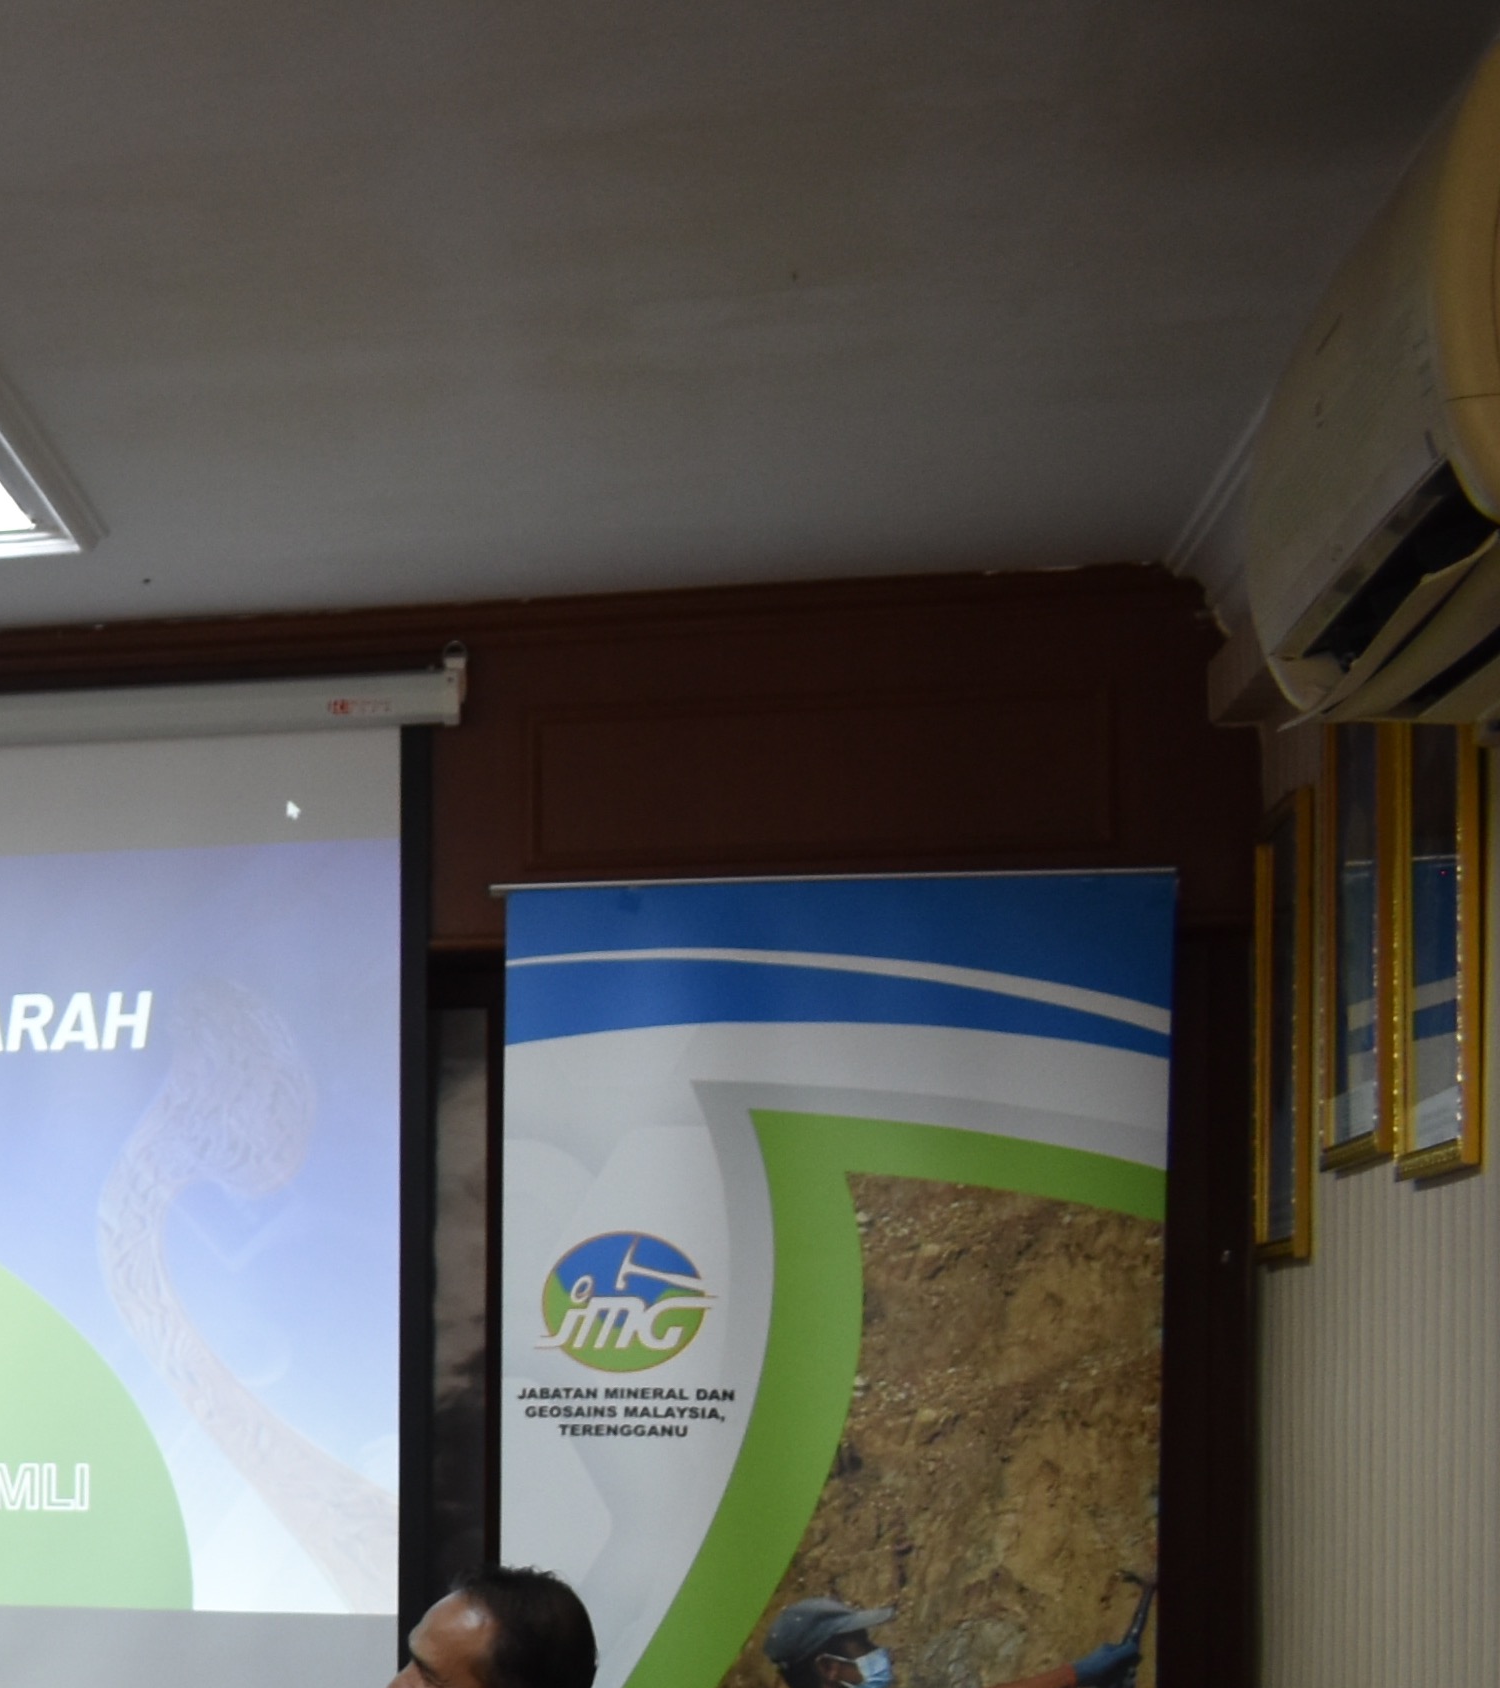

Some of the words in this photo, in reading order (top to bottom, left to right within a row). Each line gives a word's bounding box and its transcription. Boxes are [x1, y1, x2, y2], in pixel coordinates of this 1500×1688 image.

[517, 1387, 598, 1400] JABATAN
[604, 1388, 689, 1401] MINERAL
[695, 1389, 735, 1402] DAN
[524, 1405, 617, 1418] GEOSAINS
[623, 1406, 726, 1422] MALAYSIA,
[558, 1423, 688, 1438] TERENGGANU
